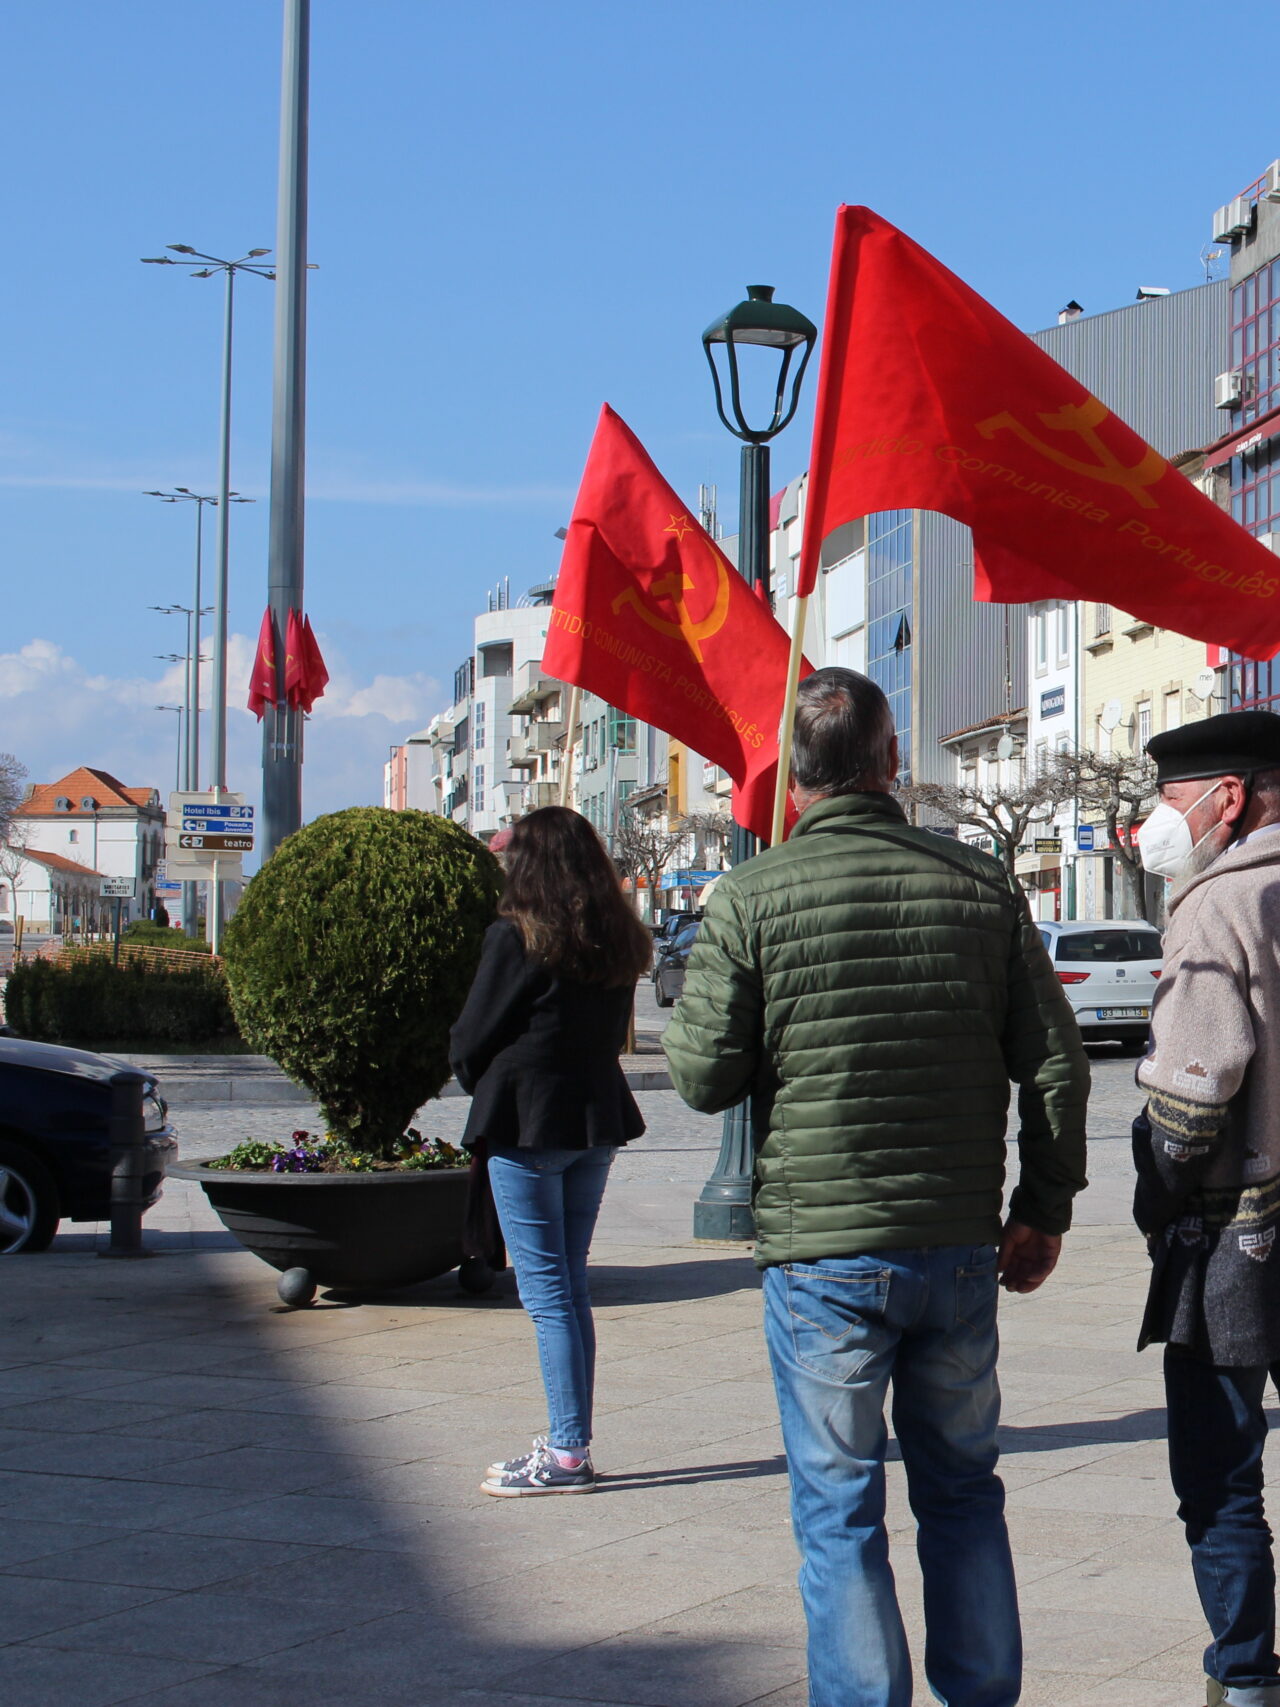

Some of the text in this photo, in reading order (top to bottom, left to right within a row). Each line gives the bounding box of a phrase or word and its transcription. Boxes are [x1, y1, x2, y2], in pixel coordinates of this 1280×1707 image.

[833, 434, 1279, 598] artido Comunista Português
[594, 628, 675, 683] COMUNISTA
[673, 674, 764, 748] PORTUGUÊS
[223, 839, 252, 848] teatro
